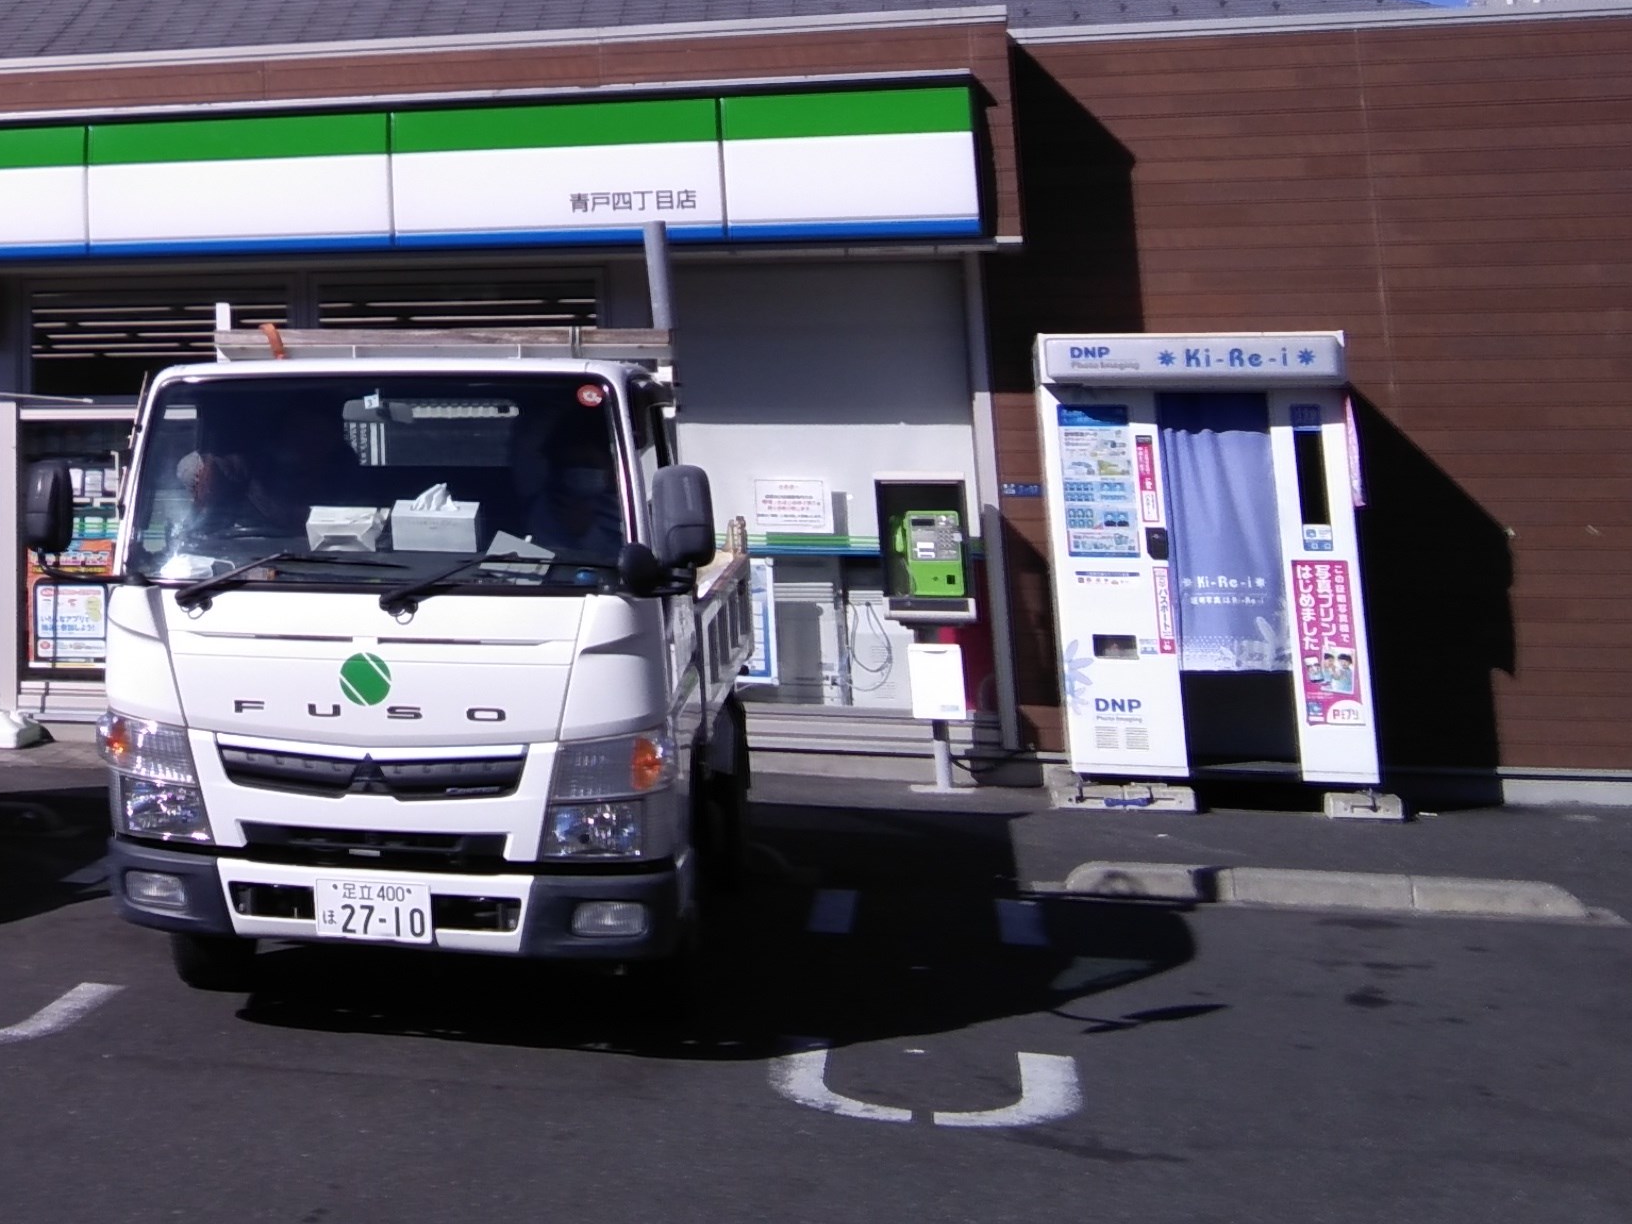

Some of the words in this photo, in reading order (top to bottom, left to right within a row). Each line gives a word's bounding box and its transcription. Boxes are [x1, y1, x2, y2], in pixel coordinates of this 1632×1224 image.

[569, 188, 696, 214] 青戸四丁目店
[1070, 346, 1110, 359] DNP
[1184, 348, 1289, 368] Ki-Re-i
[1296, 564, 1320, 651] はじめました
[1315, 564, 1337, 652] 写真プリント
[233, 699, 507, 722] FUSO
[1095, 698, 1142, 714] DNP
[322, 909, 337, 925] ほ
[340, 903, 425, 938] 27-10
